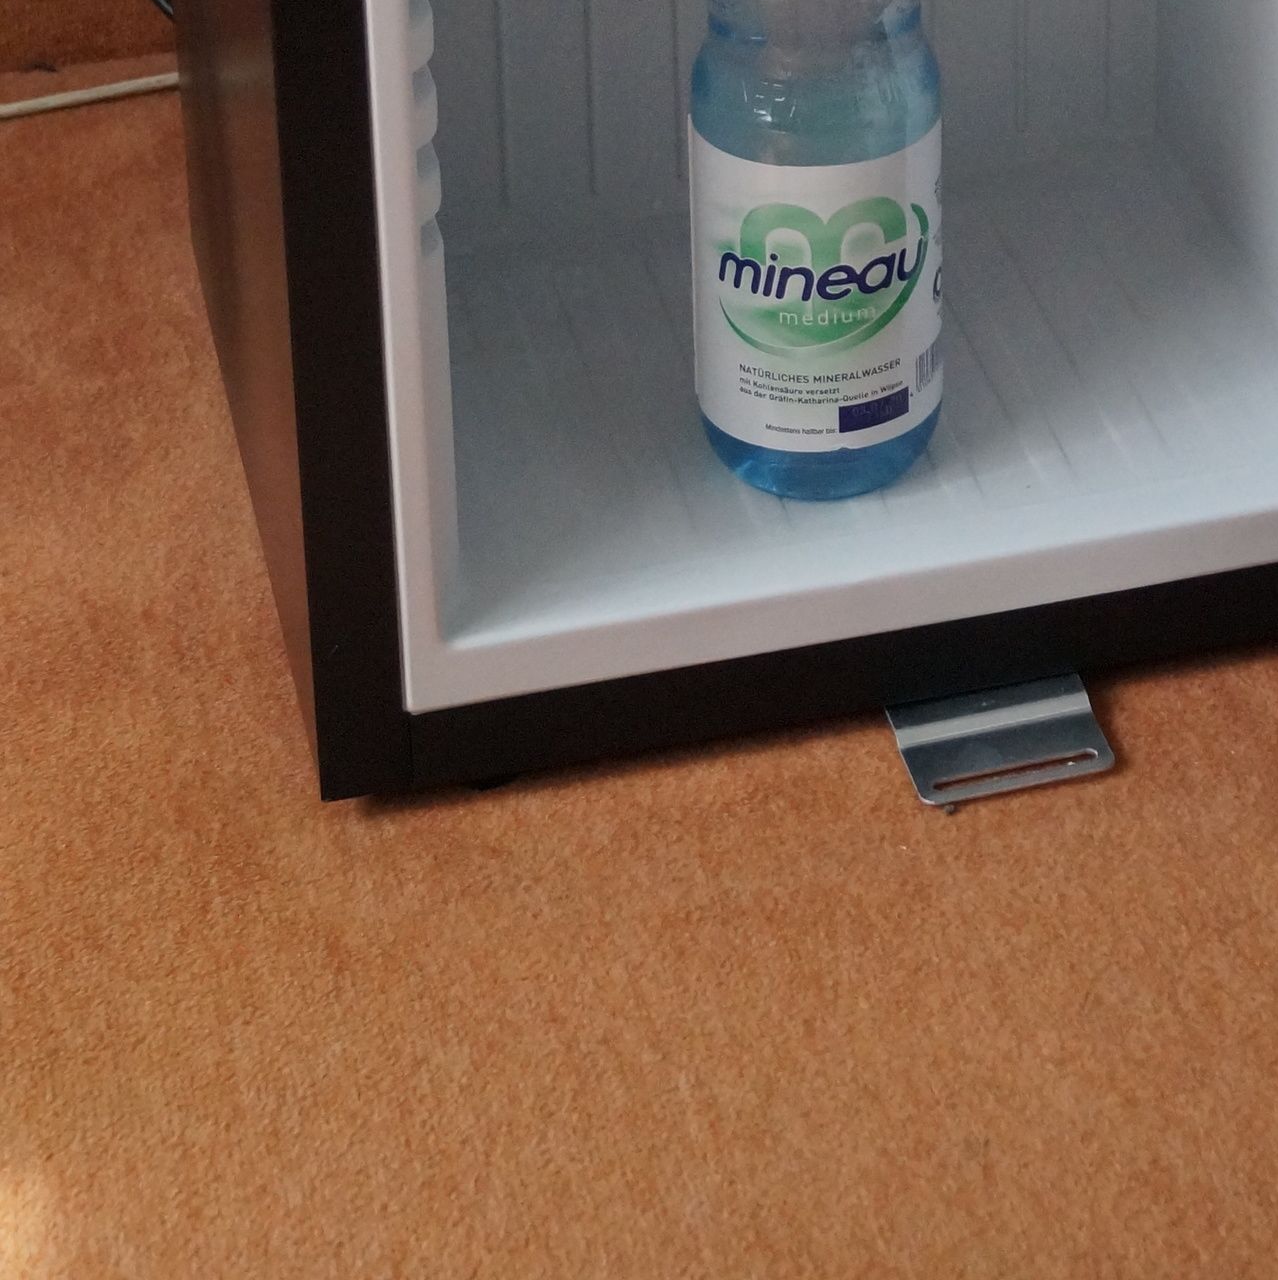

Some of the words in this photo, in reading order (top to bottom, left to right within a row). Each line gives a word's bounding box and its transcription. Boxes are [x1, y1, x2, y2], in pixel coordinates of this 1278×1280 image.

[718, 237, 924, 302] mineau
[779, 306, 876, 326] medium
[739, 363, 810, 384] NATÜRLICHES
[813, 357, 902, 384] MINERALWASSER
[739, 376, 751, 387] mit
[753, 380, 804, 396] Kohlensäure
[806, 386, 840, 396] versetzt
[739, 386, 752, 395] aus
[754, 389, 767, 399] der
[769, 391, 870, 405] Gräfin-Katharina-Quelle
